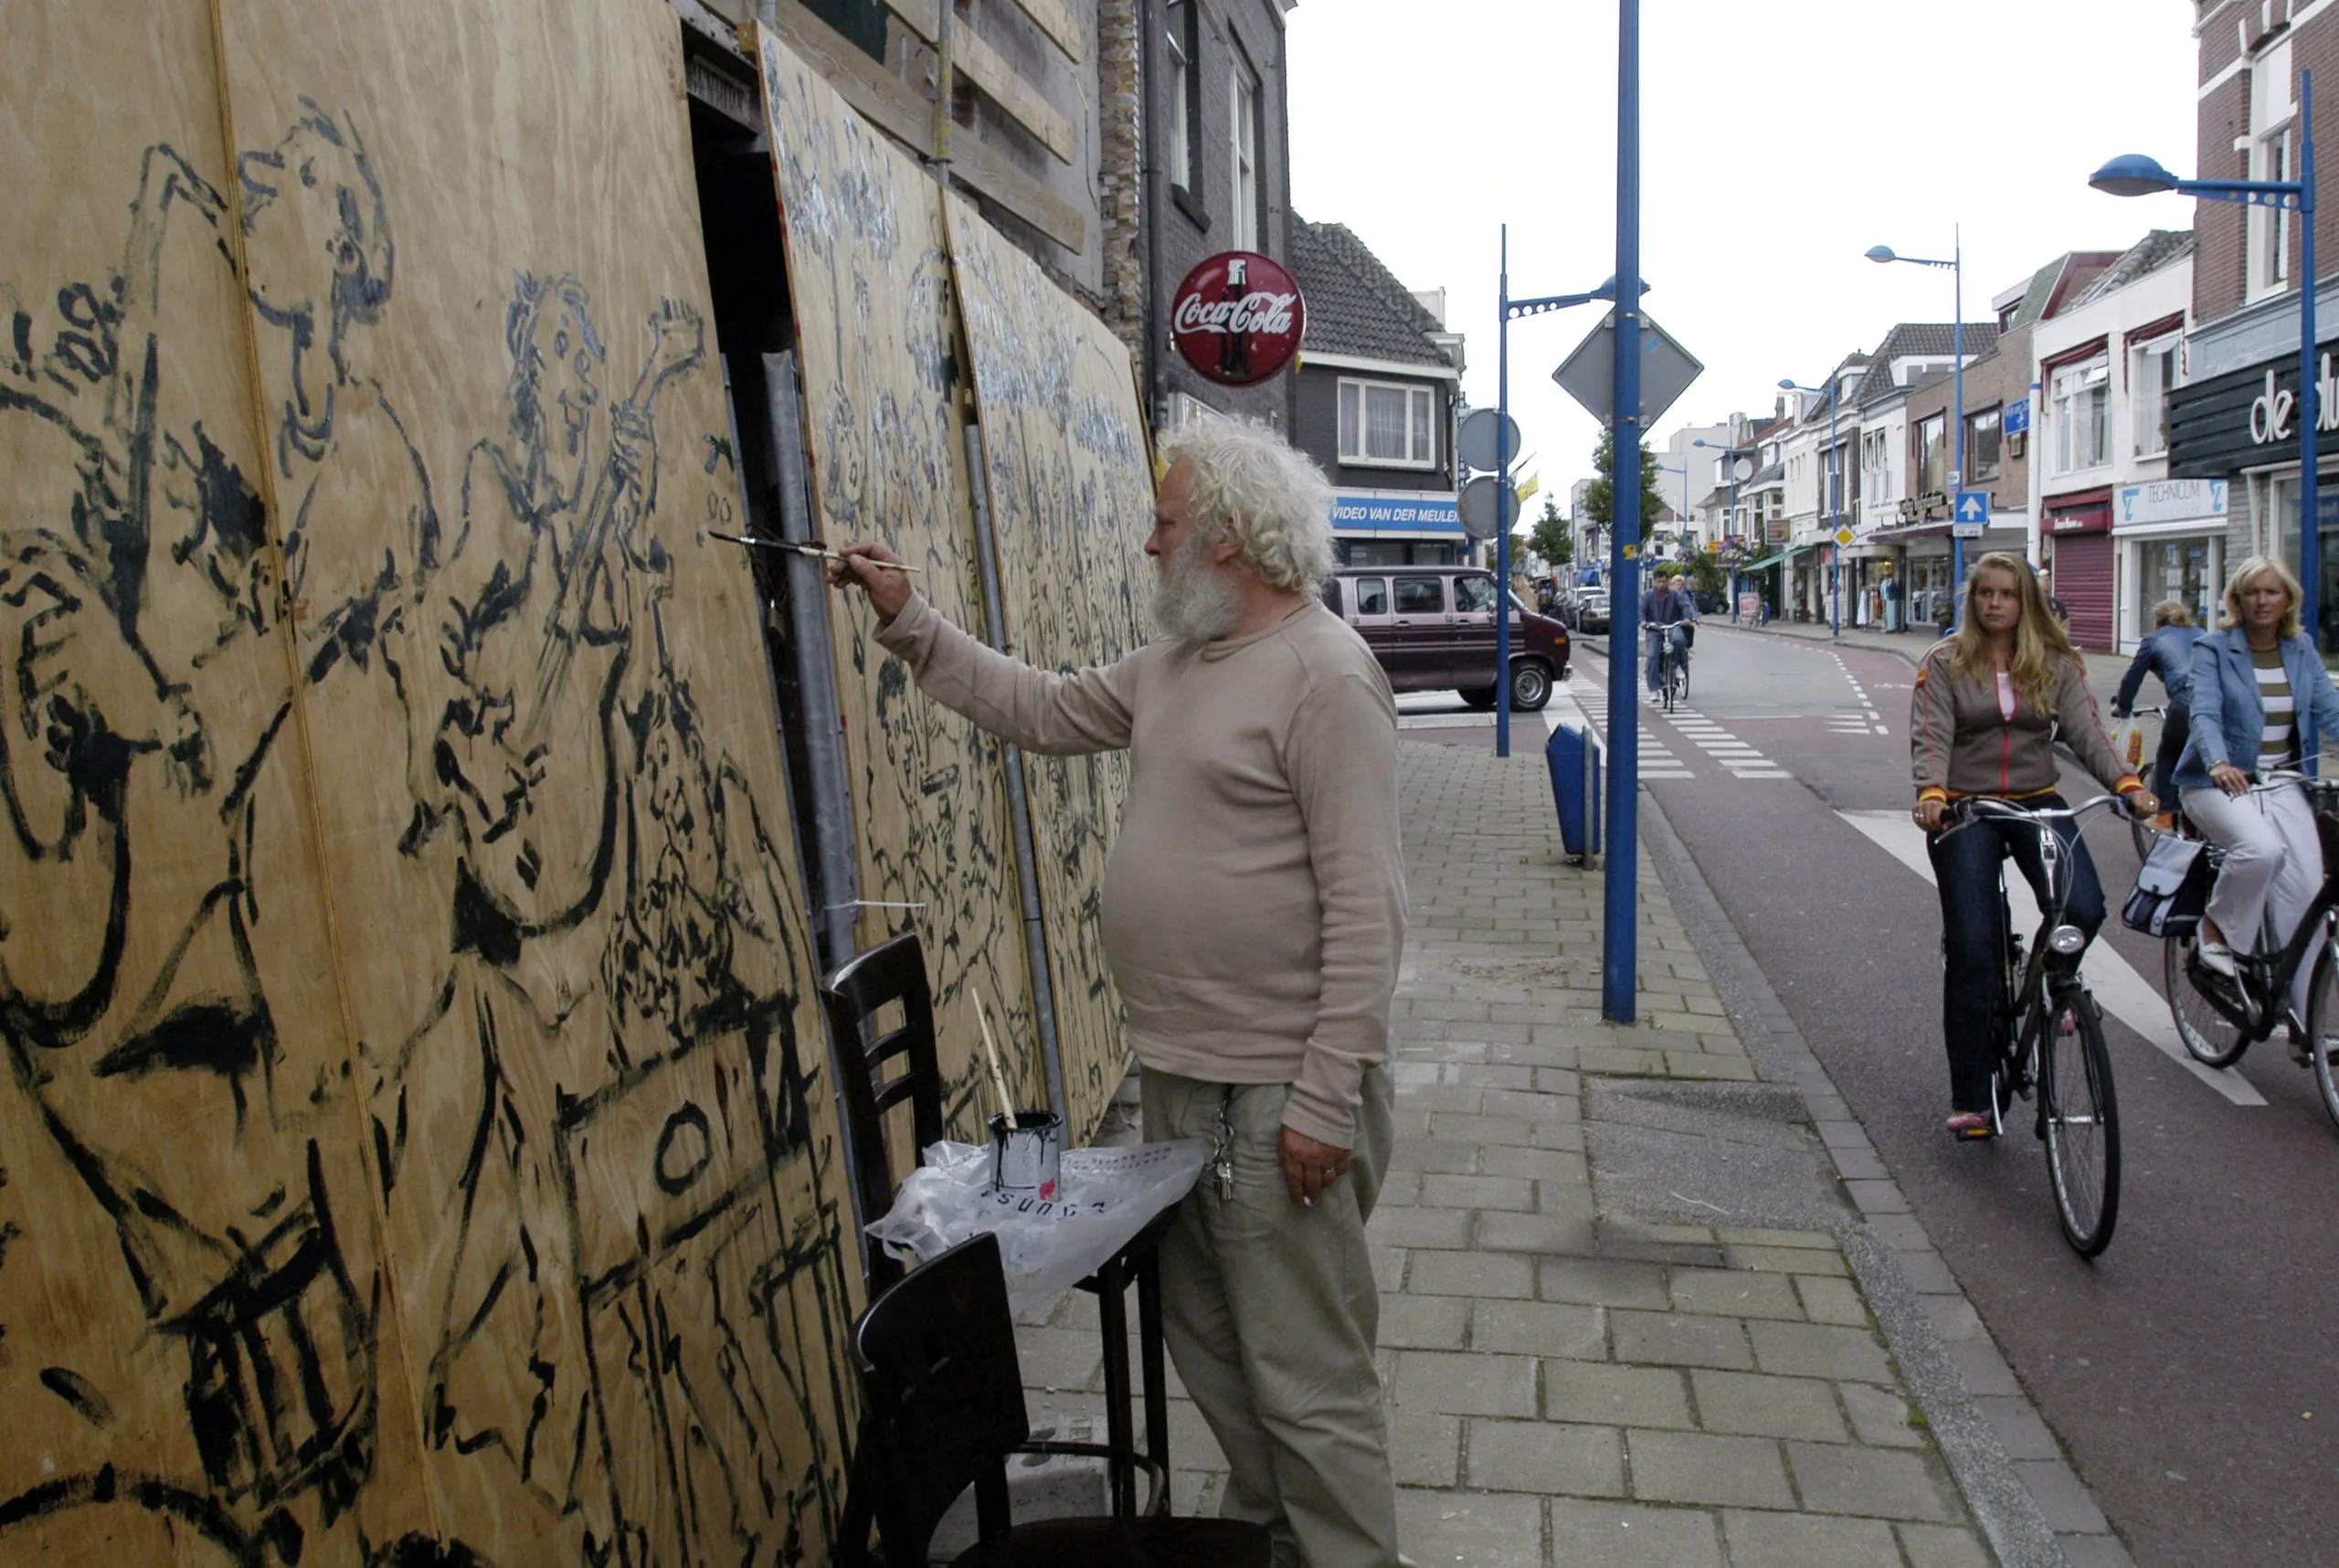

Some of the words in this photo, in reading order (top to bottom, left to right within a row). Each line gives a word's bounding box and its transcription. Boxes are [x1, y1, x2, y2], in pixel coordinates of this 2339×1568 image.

[1175, 291, 1297, 334] Coca-Cola
[2249, 369, 2294, 444] de
[2148, 481, 2200, 503] TECHNICUM
[1333, 505, 1367, 520] VIDEO
[1370, 507, 1392, 521] VAN
[1392, 508, 1417, 522] DER
